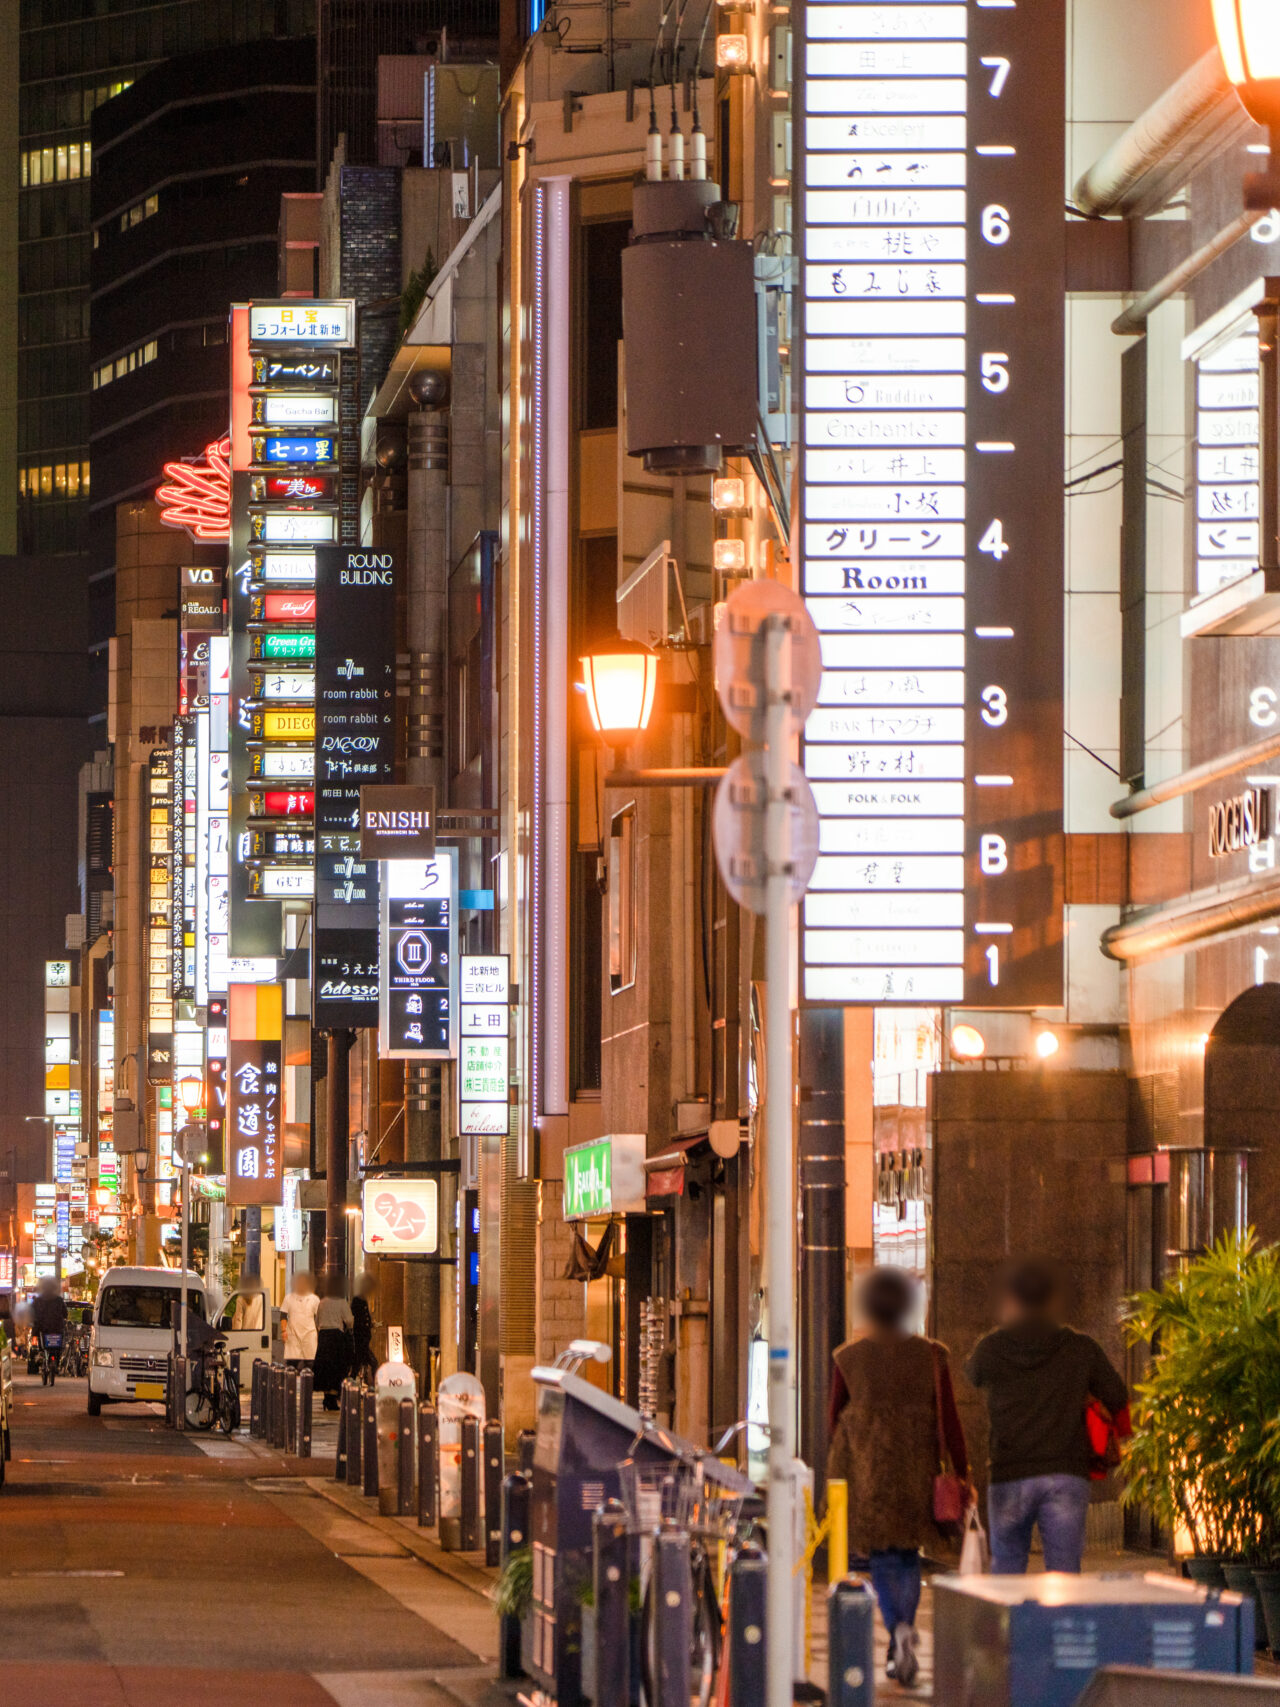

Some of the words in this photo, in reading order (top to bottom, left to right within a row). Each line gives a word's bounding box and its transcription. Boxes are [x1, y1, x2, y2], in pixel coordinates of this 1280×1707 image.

[979, 56, 1010, 98] 7
[981, 203, 1010, 246] 6
[281, 310, 318, 323] 日宝
[257, 323, 341, 336] ラフォーレ北新地
[269, 363, 332, 377] アーベント
[981, 352, 1009, 394] 5
[314, 407, 329, 415] Bar
[270, 440, 331, 460] 七つ星
[886, 491, 939, 515] 小坂
[826, 528, 941, 551] グリーン
[977, 518, 1009, 561] 4
[348, 554, 393, 569] ROUND
[189, 569, 214, 583] V.O.
[340, 570, 393, 585] BUILDING
[842, 567, 928, 590] Room
[182, 604, 187, 612] 8
[188, 606, 220, 614] REGALO
[182, 650, 187, 658] 7
[253, 636, 262, 659] 4F
[268, 636, 299, 646] Green
[253, 677, 262, 696] 3F
[323, 690, 347, 698] room
[351, 688, 378, 698] rabbit
[981, 685, 1008, 727] 3
[323, 715, 347, 723] room
[351, 713, 378, 723] rabbit
[253, 716, 262, 736] 3F
[252, 755, 261, 773] 2F
[322, 789, 342, 797] 前田
[848, 793, 878, 804] FOLK
[890, 793, 921, 804] FOLK
[324, 815, 352, 823] Lounge
[366, 811, 431, 828] ENISHI
[253, 834, 261, 851] 1F
[981, 834, 1008, 875] B
[334, 864, 346, 874] SEVEN
[353, 864, 366, 874] FLOOR
[253, 873, 261, 892] 1F
[420, 863, 439, 890] 5
[334, 889, 346, 899] SEVEN
[353, 889, 366, 899] FLOOR
[440, 900, 448, 910] 5
[440, 916, 448, 925] 4
[440, 953, 448, 964] 3
[985, 944, 999, 987] 1
[341, 964, 378, 975] うえだ
[469, 966, 500, 976] 北新地
[321, 981, 378, 995] Adesso
[440, 999, 448, 1010] 2
[468, 1013, 501, 1027] 上田
[441, 1029, 447, 1040] 1
[467, 1046, 502, 1057] 不動産
[467, 1060, 502, 1072] 店舗仲介
[464, 1114, 503, 1132] milano
[389, 1378, 403, 1388] NO
